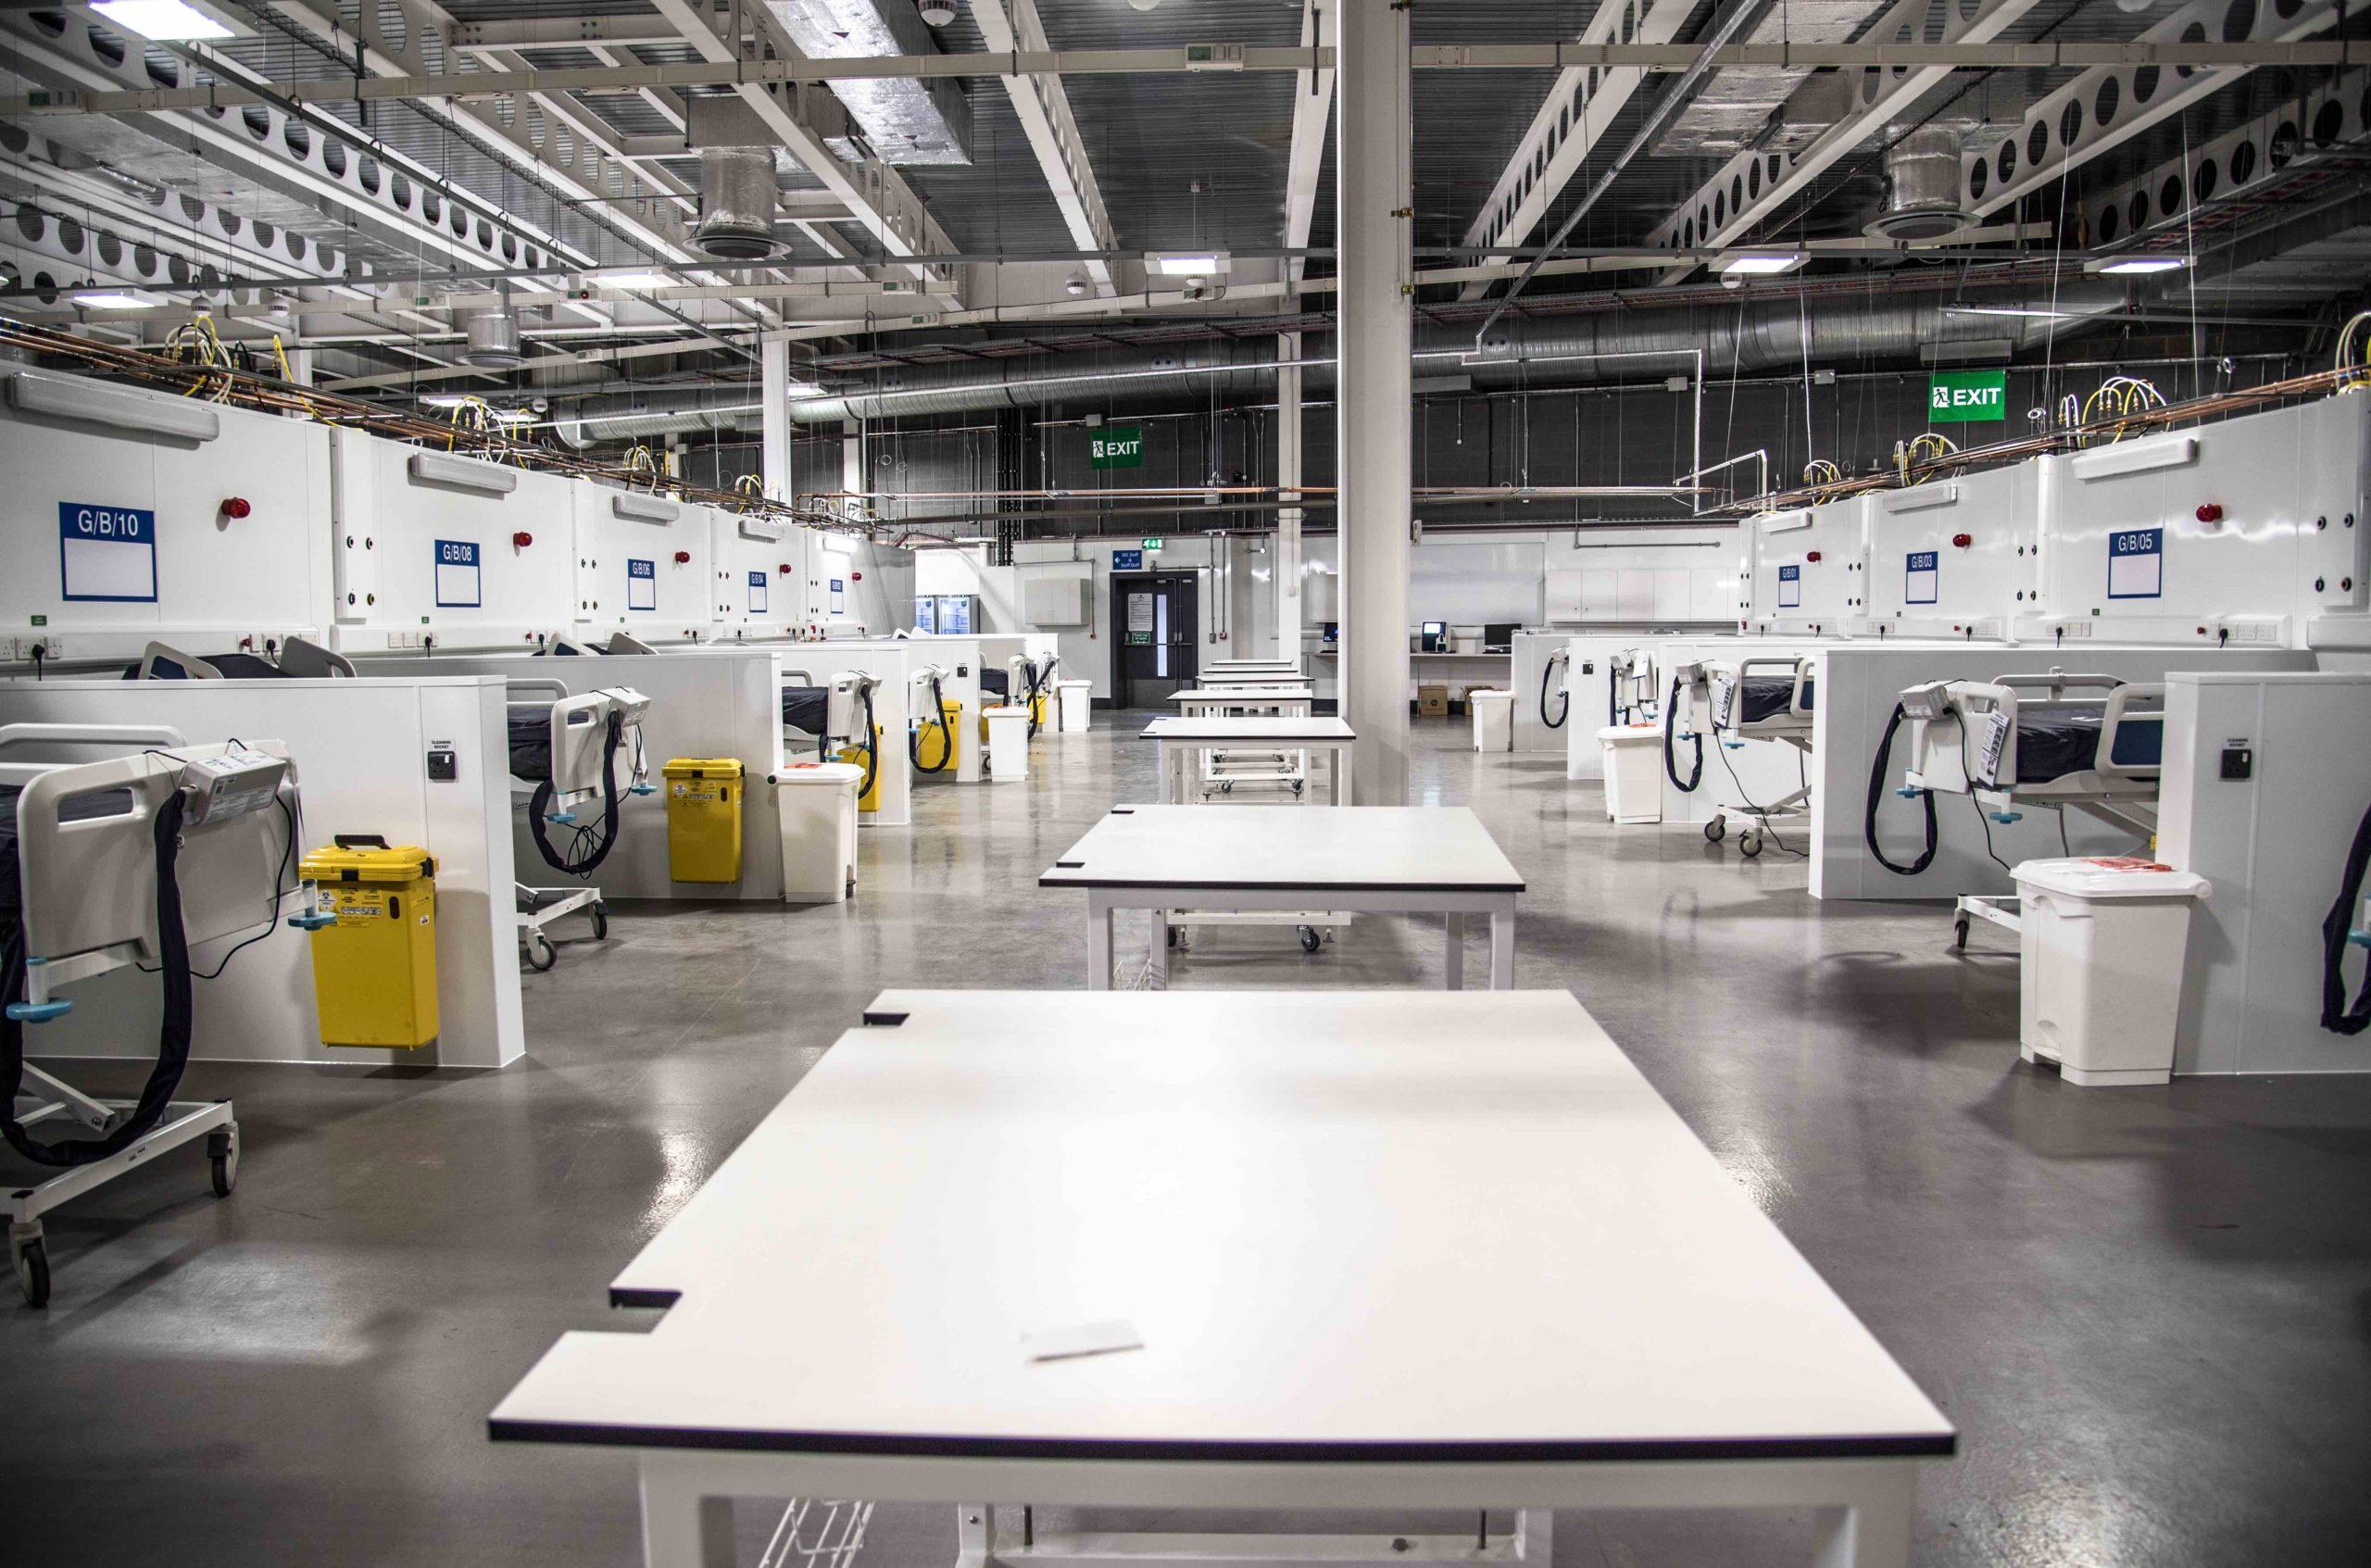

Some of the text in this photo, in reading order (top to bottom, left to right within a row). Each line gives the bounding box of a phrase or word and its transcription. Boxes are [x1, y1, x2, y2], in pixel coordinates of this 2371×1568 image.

[1953, 387, 2001, 406] EXIT
[1107, 441, 1139, 456] EXIT
[78, 509, 138, 536] G/B/10
[2118, 533, 2152, 553] G/B/05
[443, 544, 472, 562] G/B/08
